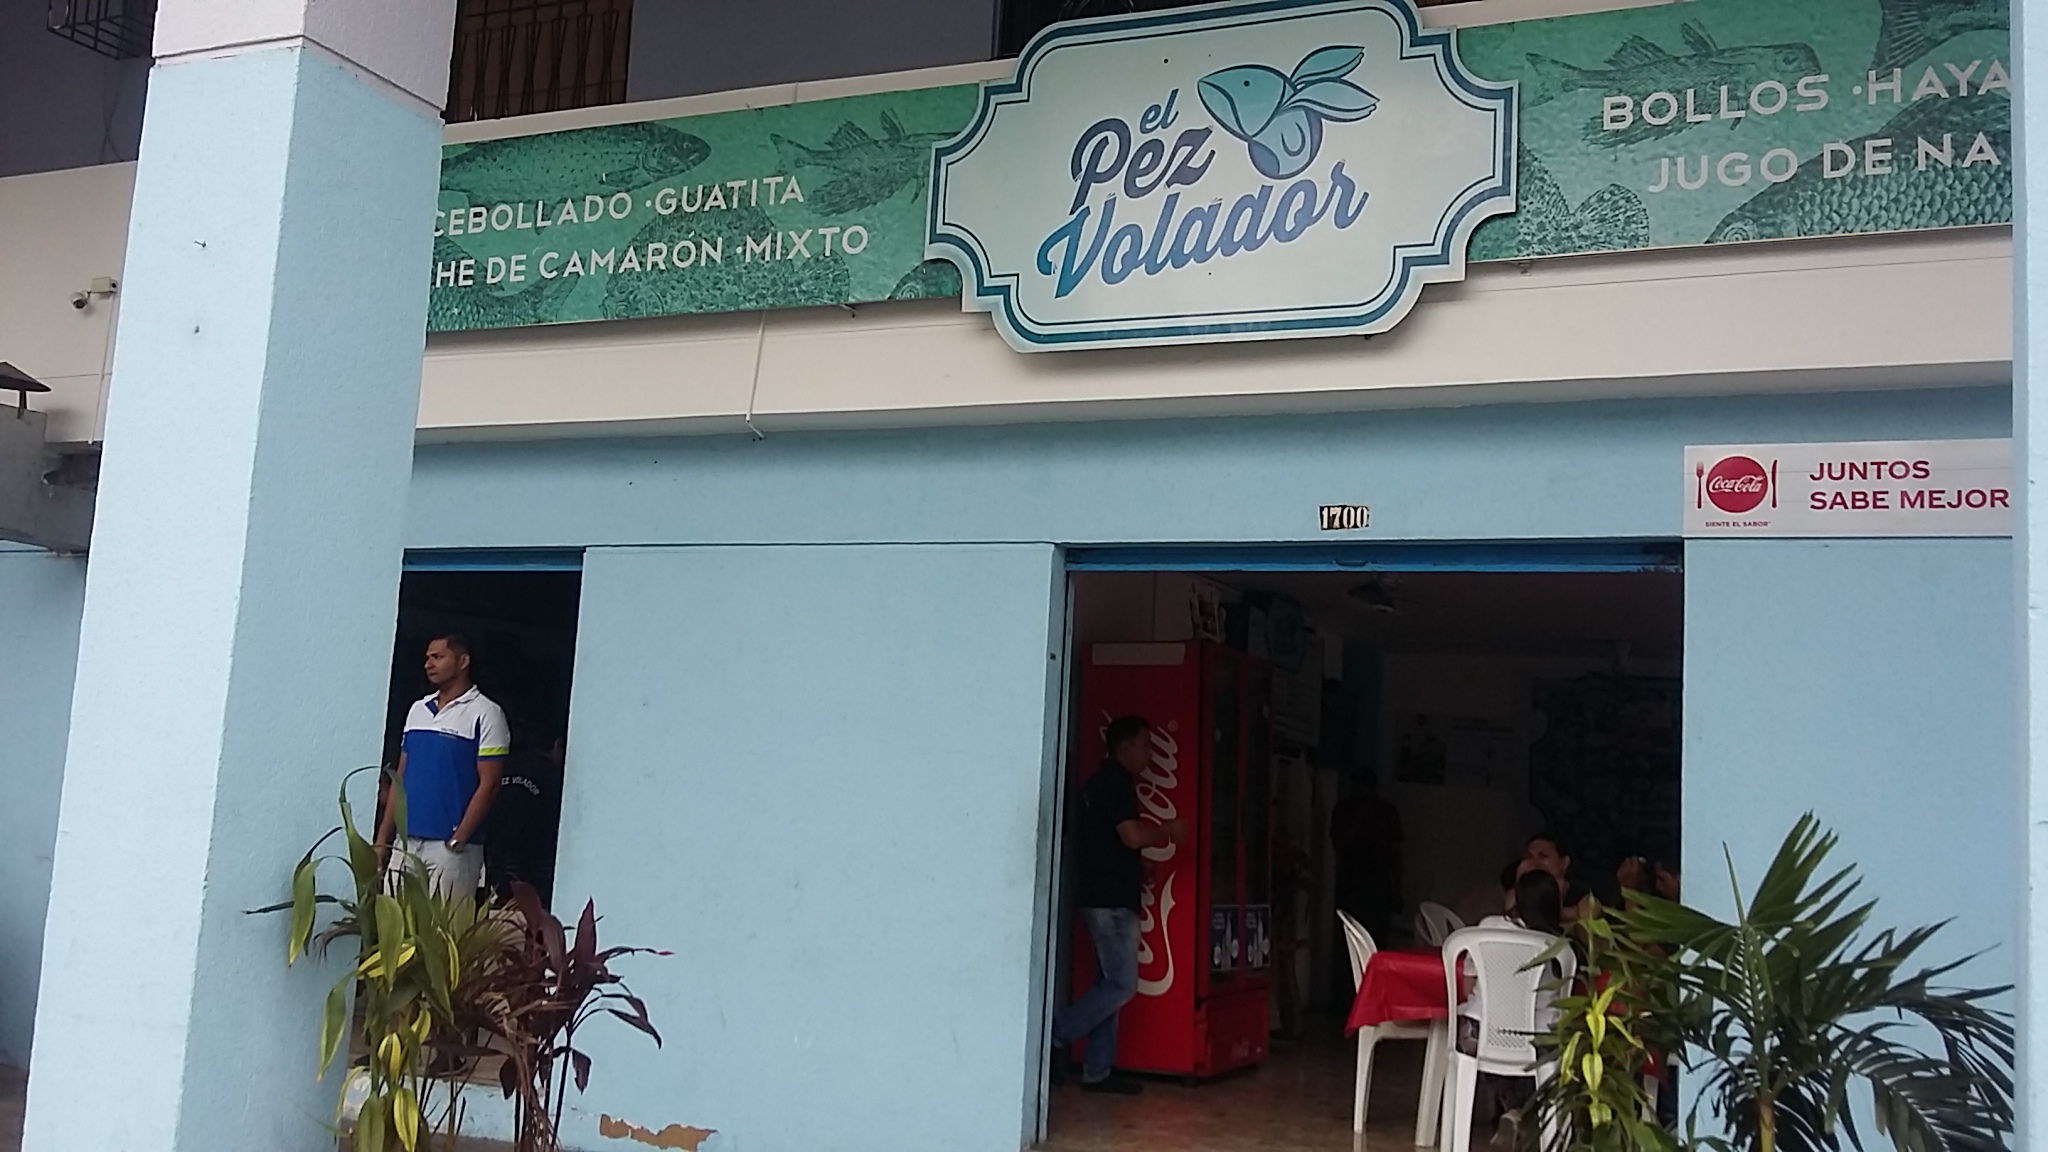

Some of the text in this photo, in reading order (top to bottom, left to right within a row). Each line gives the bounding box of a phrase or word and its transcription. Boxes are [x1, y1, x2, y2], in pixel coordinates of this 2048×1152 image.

[1140, 88, 1179, 134] el
[1602, 74, 1830, 131] BOLLOS
[1070, 118, 1216, 215] Pez
[1648, 148, 1798, 193] JUGO
[1822, 138, 1893, 179] DE
[1036, 159, 1370, 299] Volador
[486, 254, 527, 284] DE
[539, 230, 723, 279] CAMARÓN
[1809, 460, 1931, 482] JUNTOS
[1321, 506, 1369, 529] 1700
[1809, 488, 2010, 511] SABE MEJOR
[512, 775, 541, 797] VOLADOR
